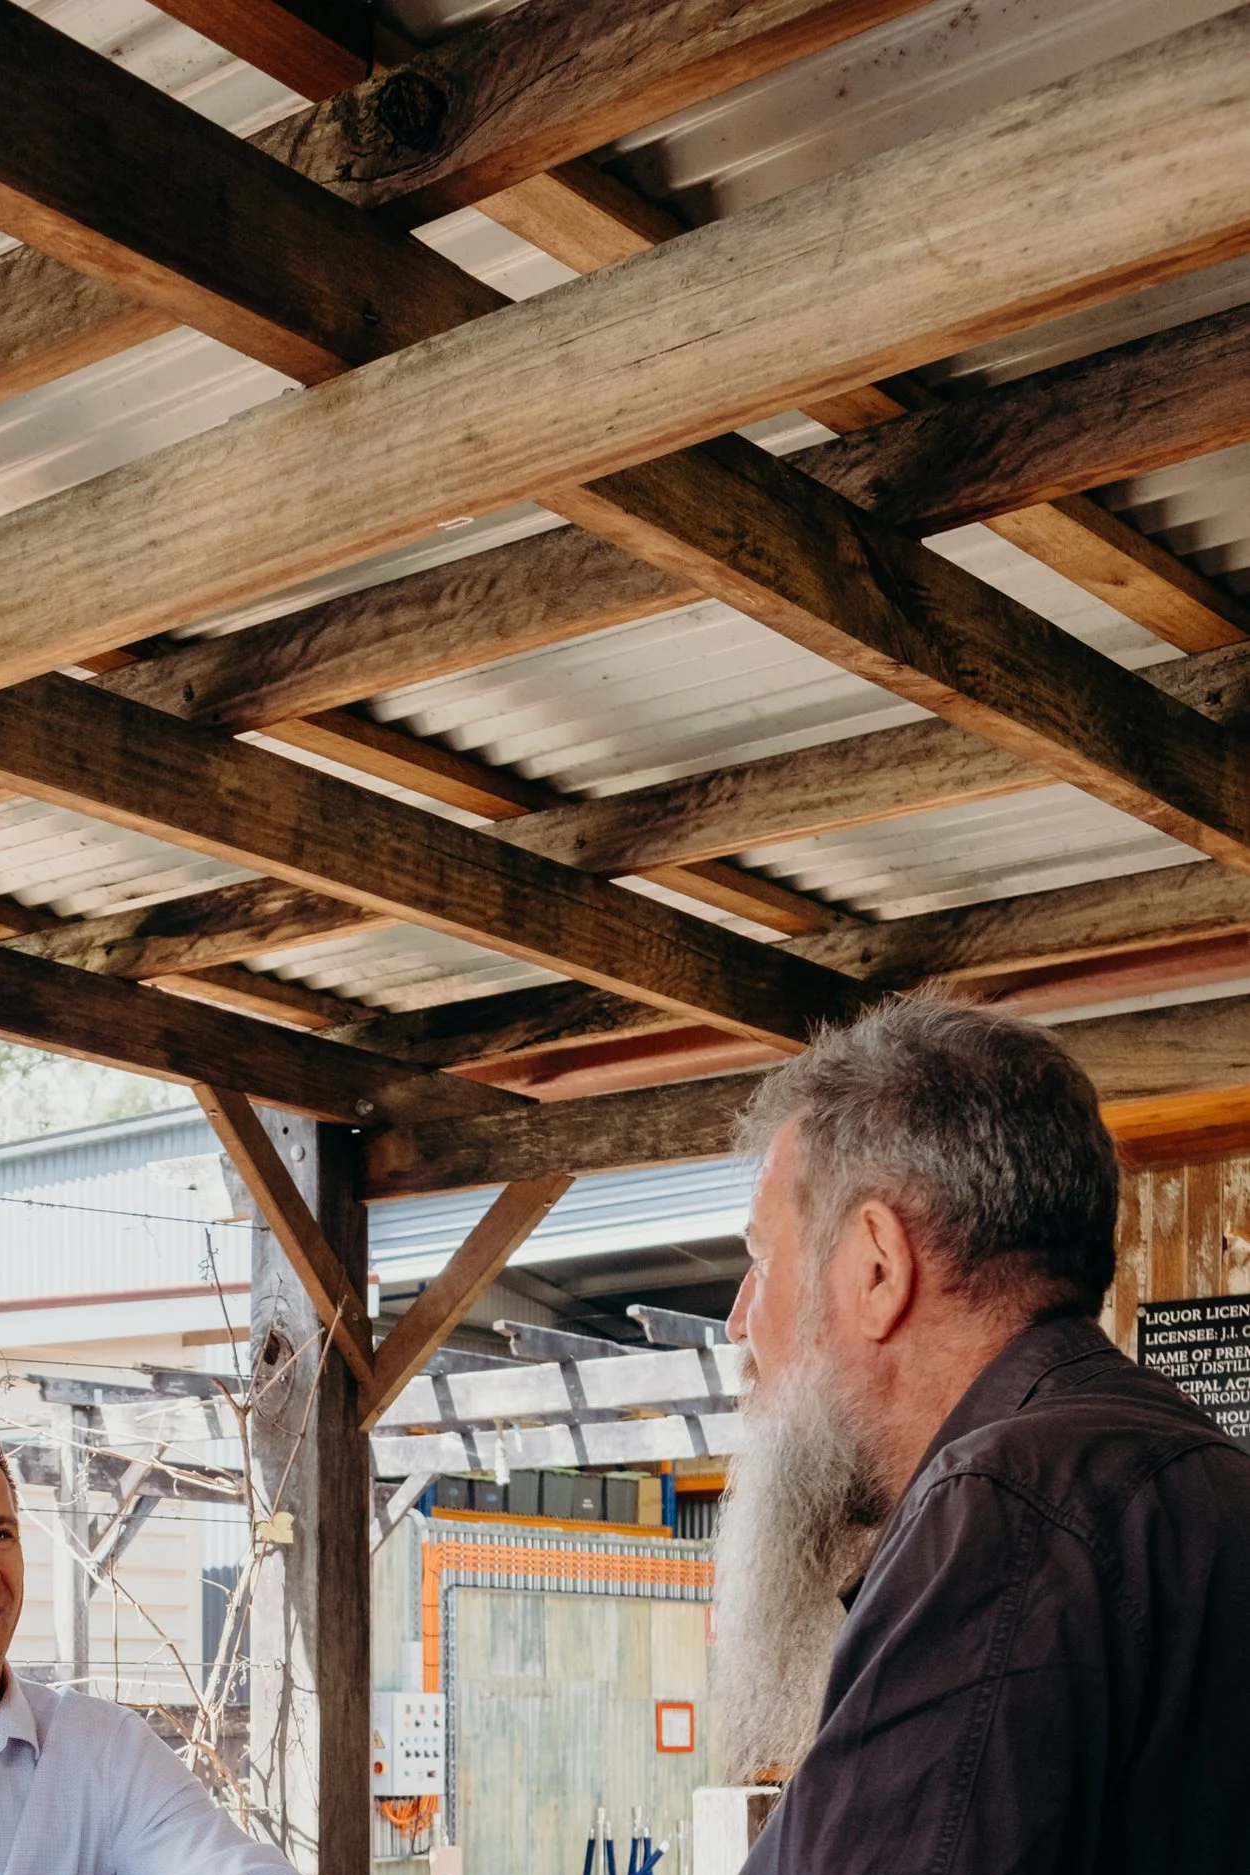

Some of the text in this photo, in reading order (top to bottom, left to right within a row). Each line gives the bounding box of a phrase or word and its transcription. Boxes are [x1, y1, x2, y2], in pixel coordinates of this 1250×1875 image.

[1145, 1304, 1250, 1326] LIQUOR LICEN
[1145, 1328, 1218, 1346] LICENSEE:
[1145, 1350, 1188, 1366] NAME
[1191, 1349, 1212, 1362] OF
[1147, 1362, 1199, 1377] CHEY
[1176, 1380, 1221, 1394] CIPAL
[1203, 1390, 1250, 1405] PRODU
[1216, 1410, 1250, 1424] HOU
